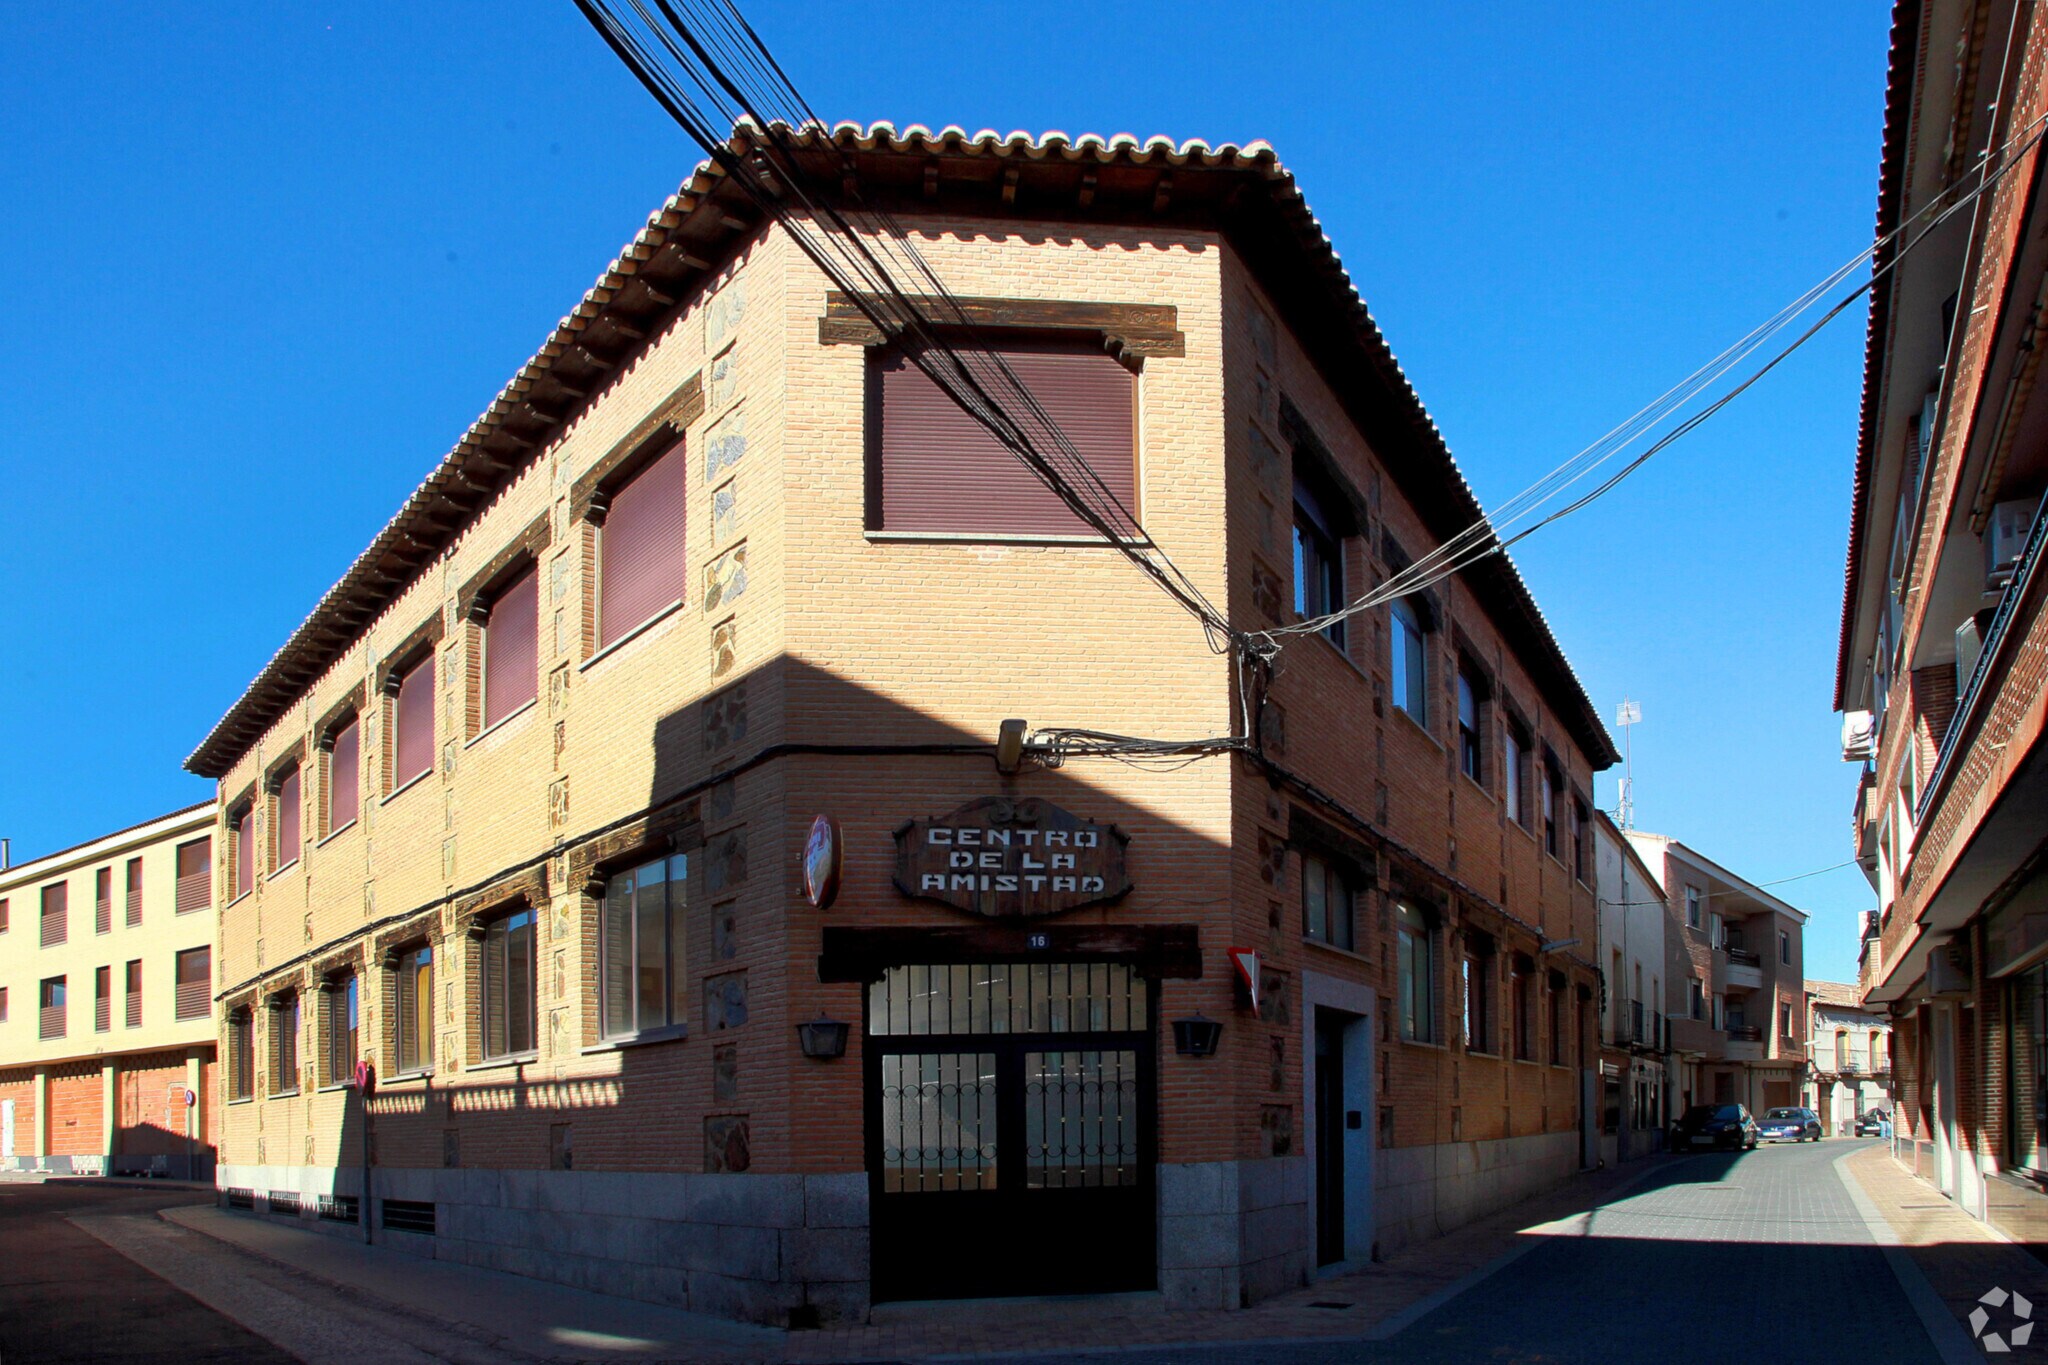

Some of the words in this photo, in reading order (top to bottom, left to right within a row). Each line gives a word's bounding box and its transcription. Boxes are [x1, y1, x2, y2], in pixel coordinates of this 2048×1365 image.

[928, 828, 1098, 848] CENTRO
[950, 851, 1003, 868] DE
[1022, 852, 1076, 869] LA
[921, 873, 1105, 892] AMISTAD
[1031, 935, 1045, 947] 16
